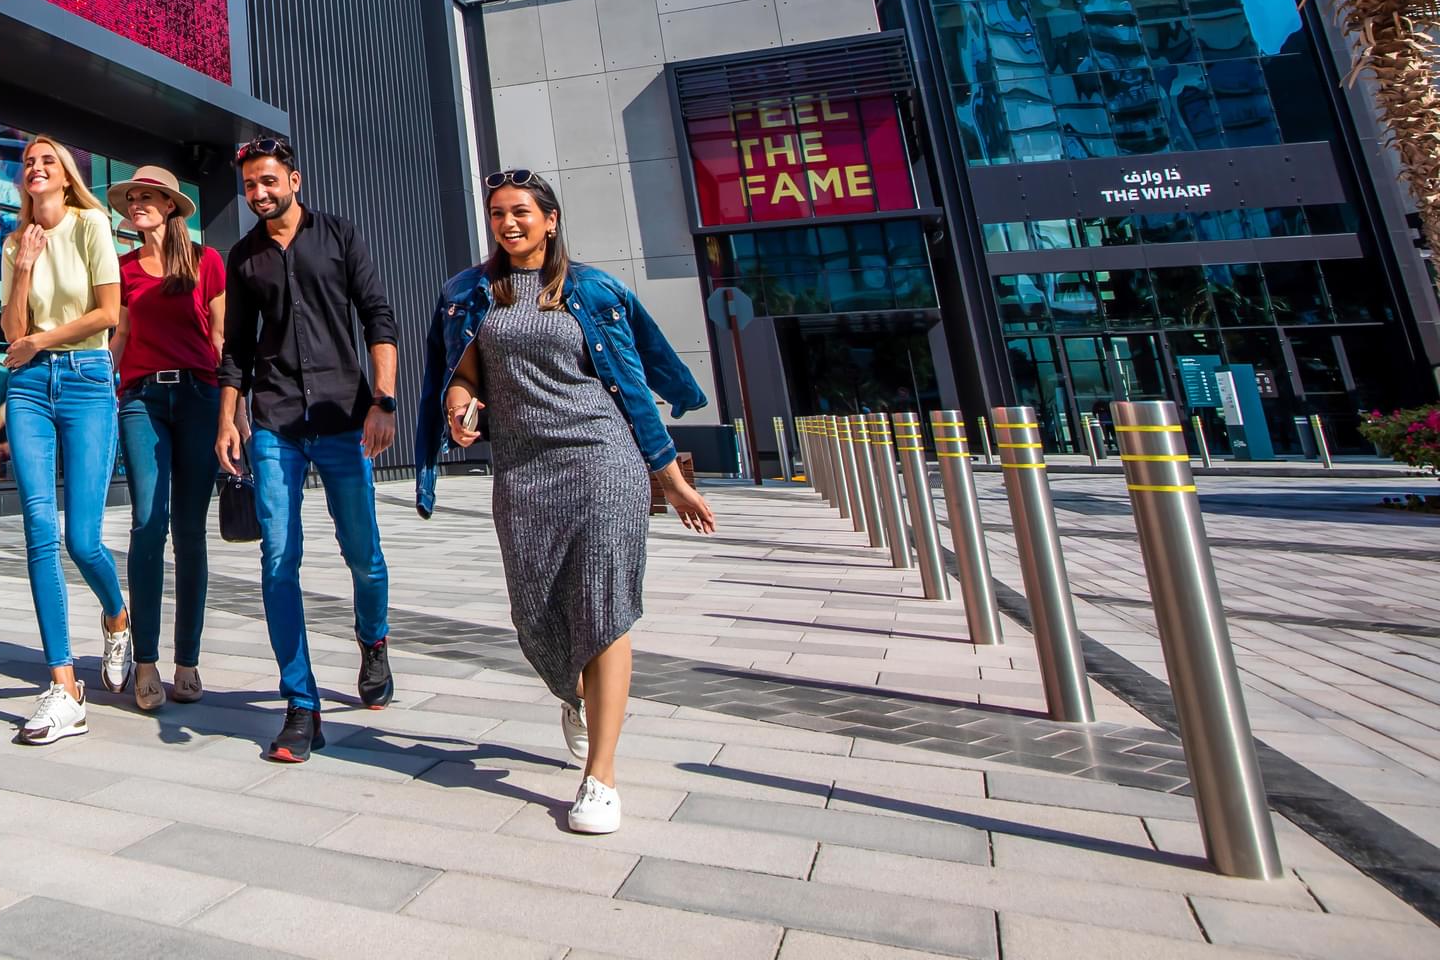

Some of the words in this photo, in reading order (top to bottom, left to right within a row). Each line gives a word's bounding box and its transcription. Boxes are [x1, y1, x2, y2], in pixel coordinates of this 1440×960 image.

[728, 93, 849, 132] FEEL
[731, 131, 828, 169] THE
[739, 164, 873, 207] FAME
[1100, 188, 1140, 203] THE
[1140, 183, 1212, 200] WHARF
